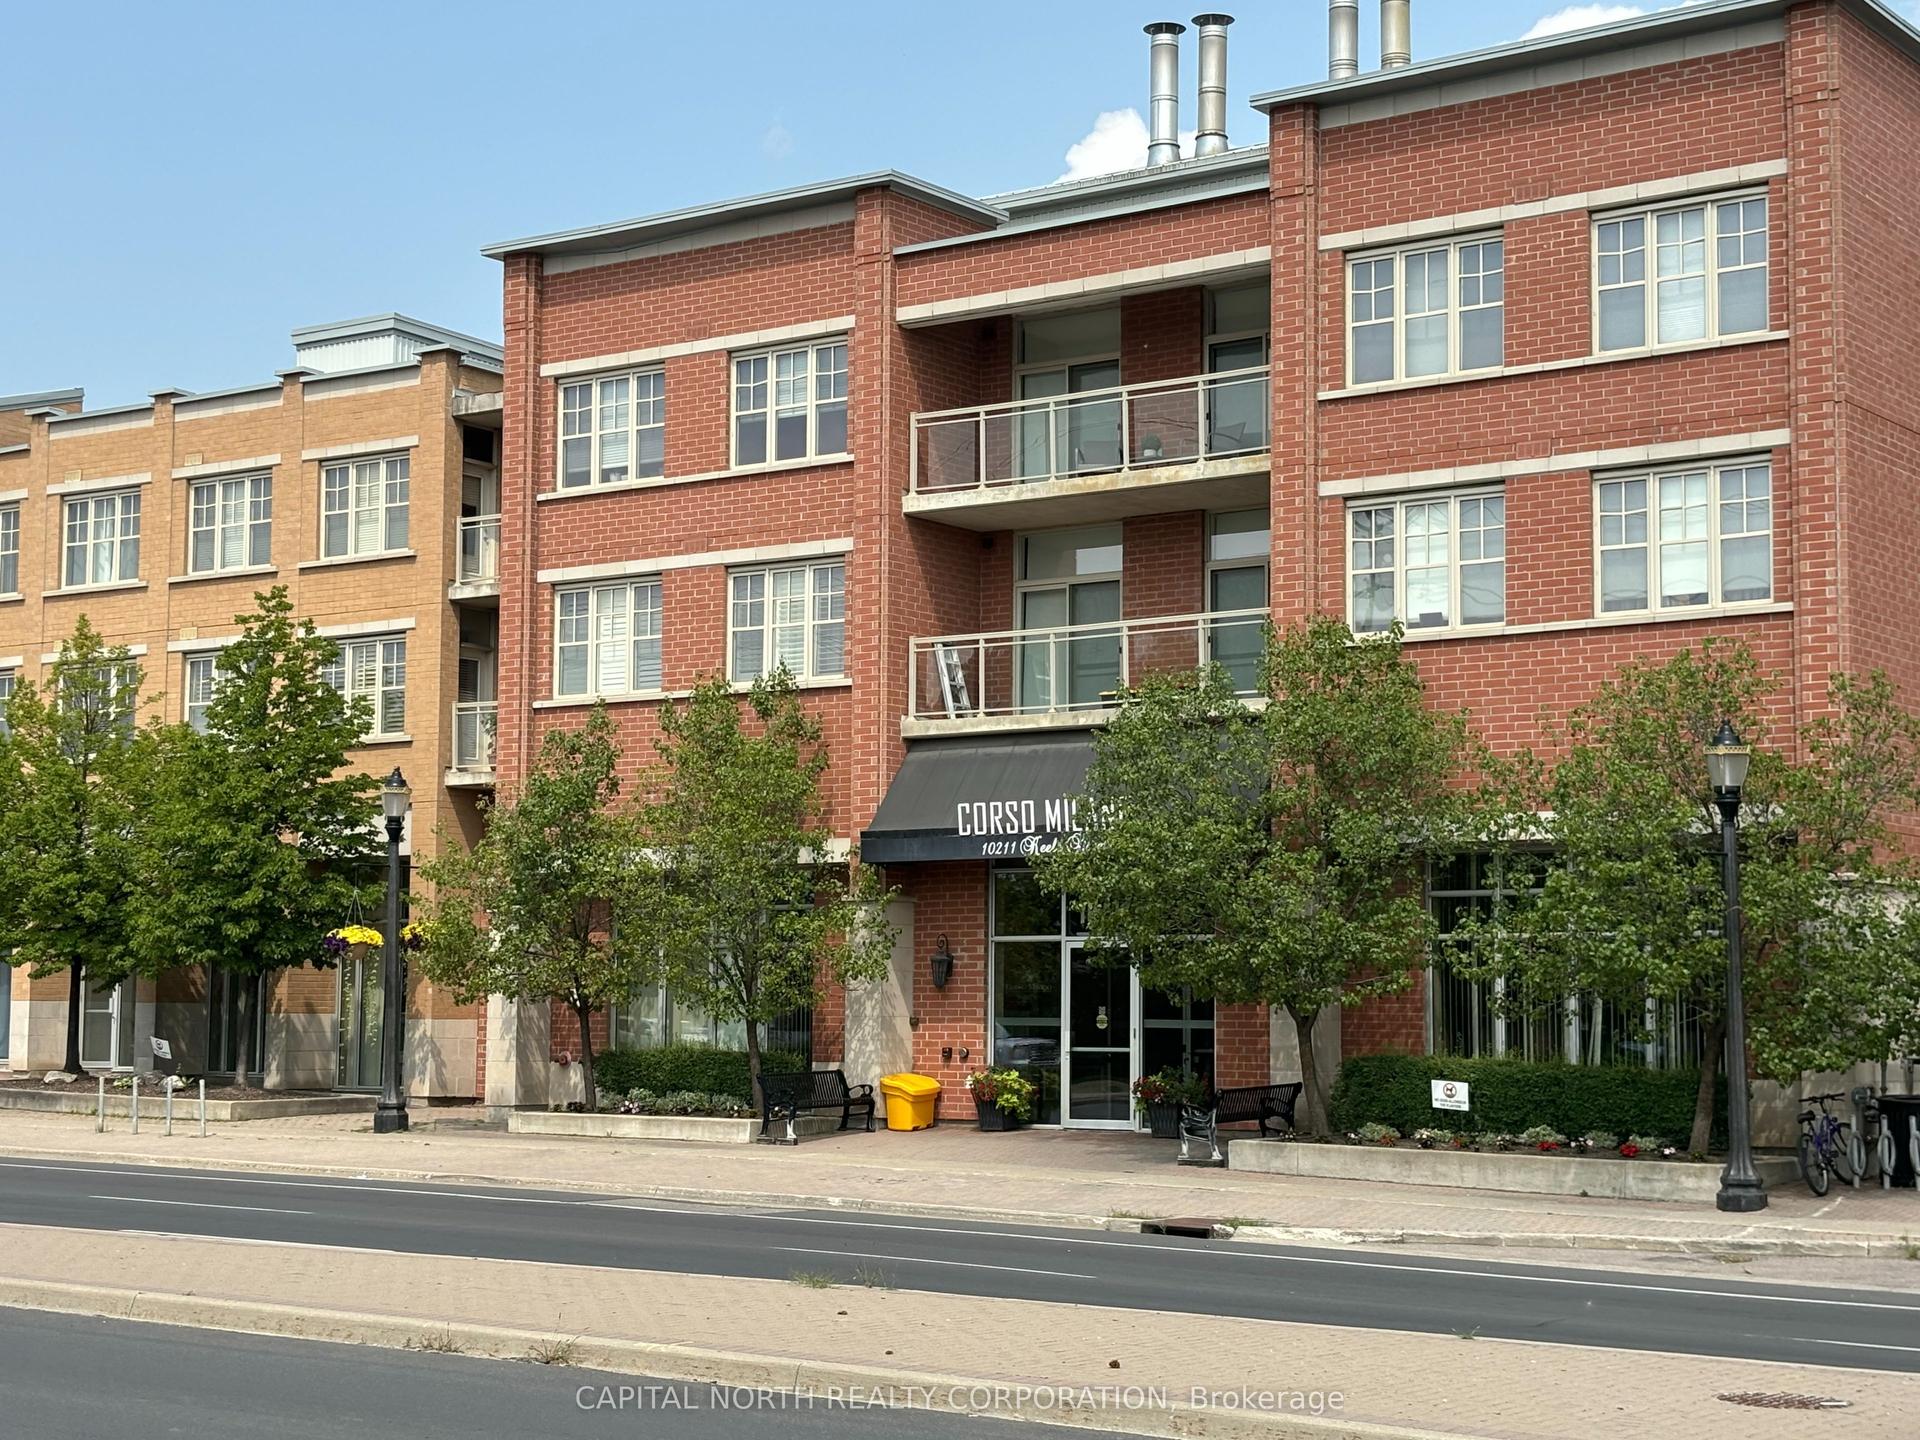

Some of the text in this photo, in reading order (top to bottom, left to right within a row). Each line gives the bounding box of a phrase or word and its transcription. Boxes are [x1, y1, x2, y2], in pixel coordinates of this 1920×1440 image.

[957, 800, 1035, 836] CORSO
[981, 841, 1017, 856] 10211
[1020, 835, 1064, 856] Keel
